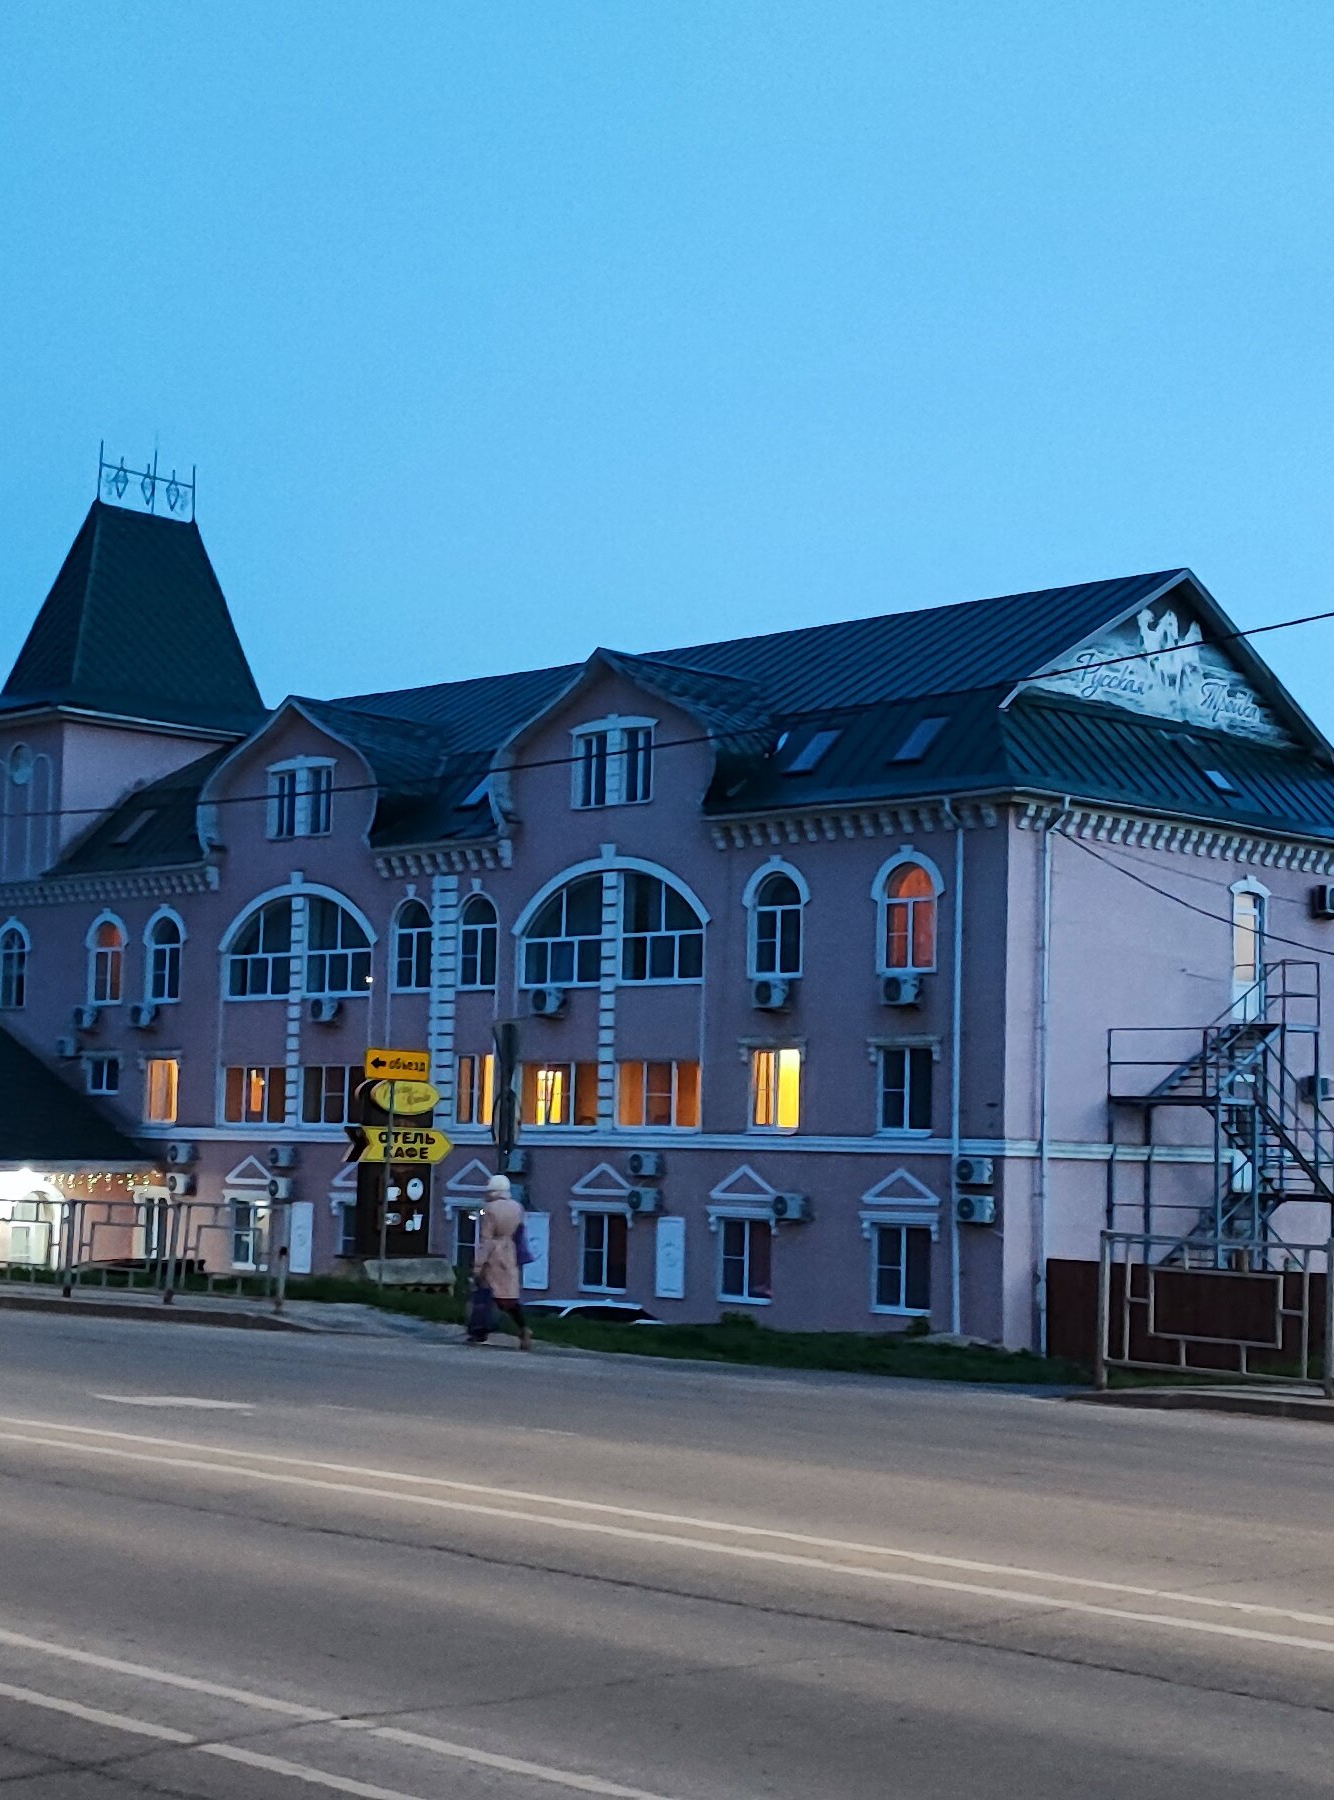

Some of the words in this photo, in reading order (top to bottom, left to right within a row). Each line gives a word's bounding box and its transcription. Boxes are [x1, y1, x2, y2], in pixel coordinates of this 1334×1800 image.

[1076, 652, 1145, 698] Русская
[389, 1057, 426, 1072] объезд
[378, 1131, 436, 1145] ОТЕЛЬ
